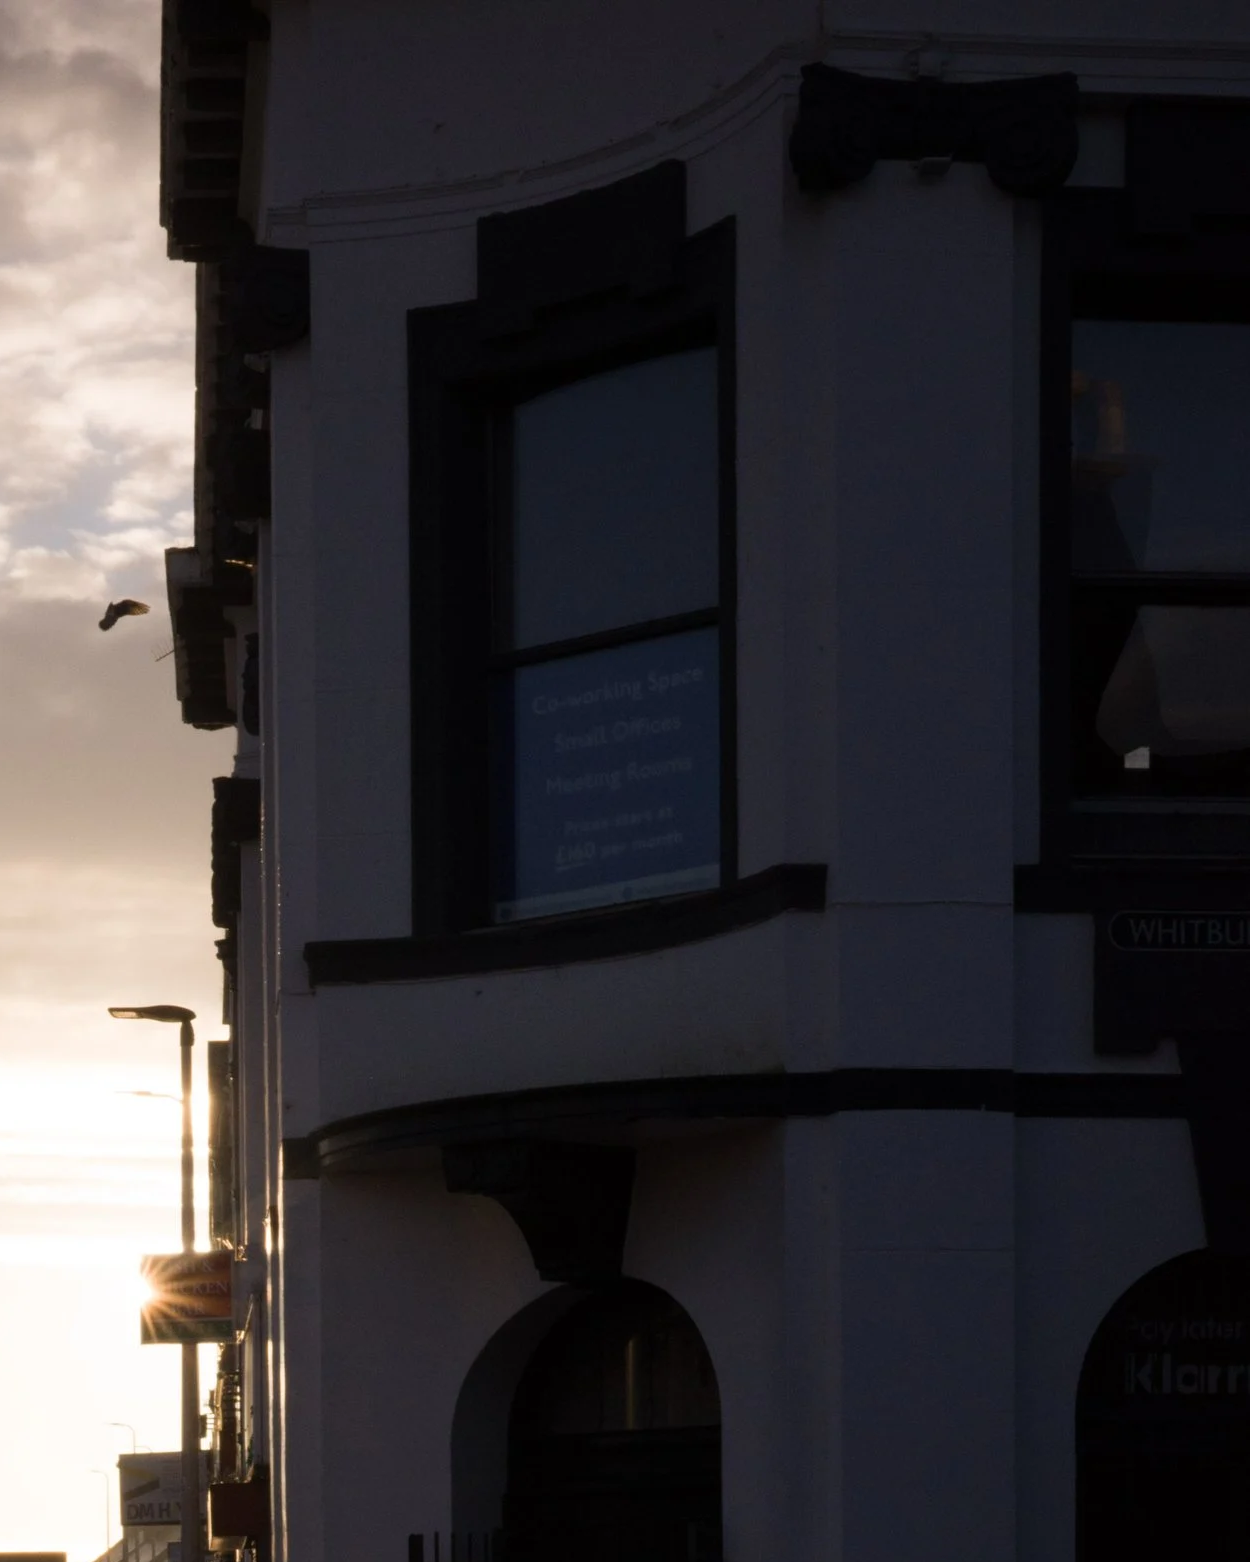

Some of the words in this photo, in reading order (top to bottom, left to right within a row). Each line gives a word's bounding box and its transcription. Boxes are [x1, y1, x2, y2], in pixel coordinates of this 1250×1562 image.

[531, 680, 645, 715] Co-working
[647, 667, 703, 693] Space
[554, 724, 608, 752] Small
[611, 715, 682, 742] Offices
[546, 769, 622, 795] Meeting
[626, 757, 693, 781] Rooms
[1128, 918, 1250, 945] WHITBU
[1180, 1314, 1244, 1341] later
